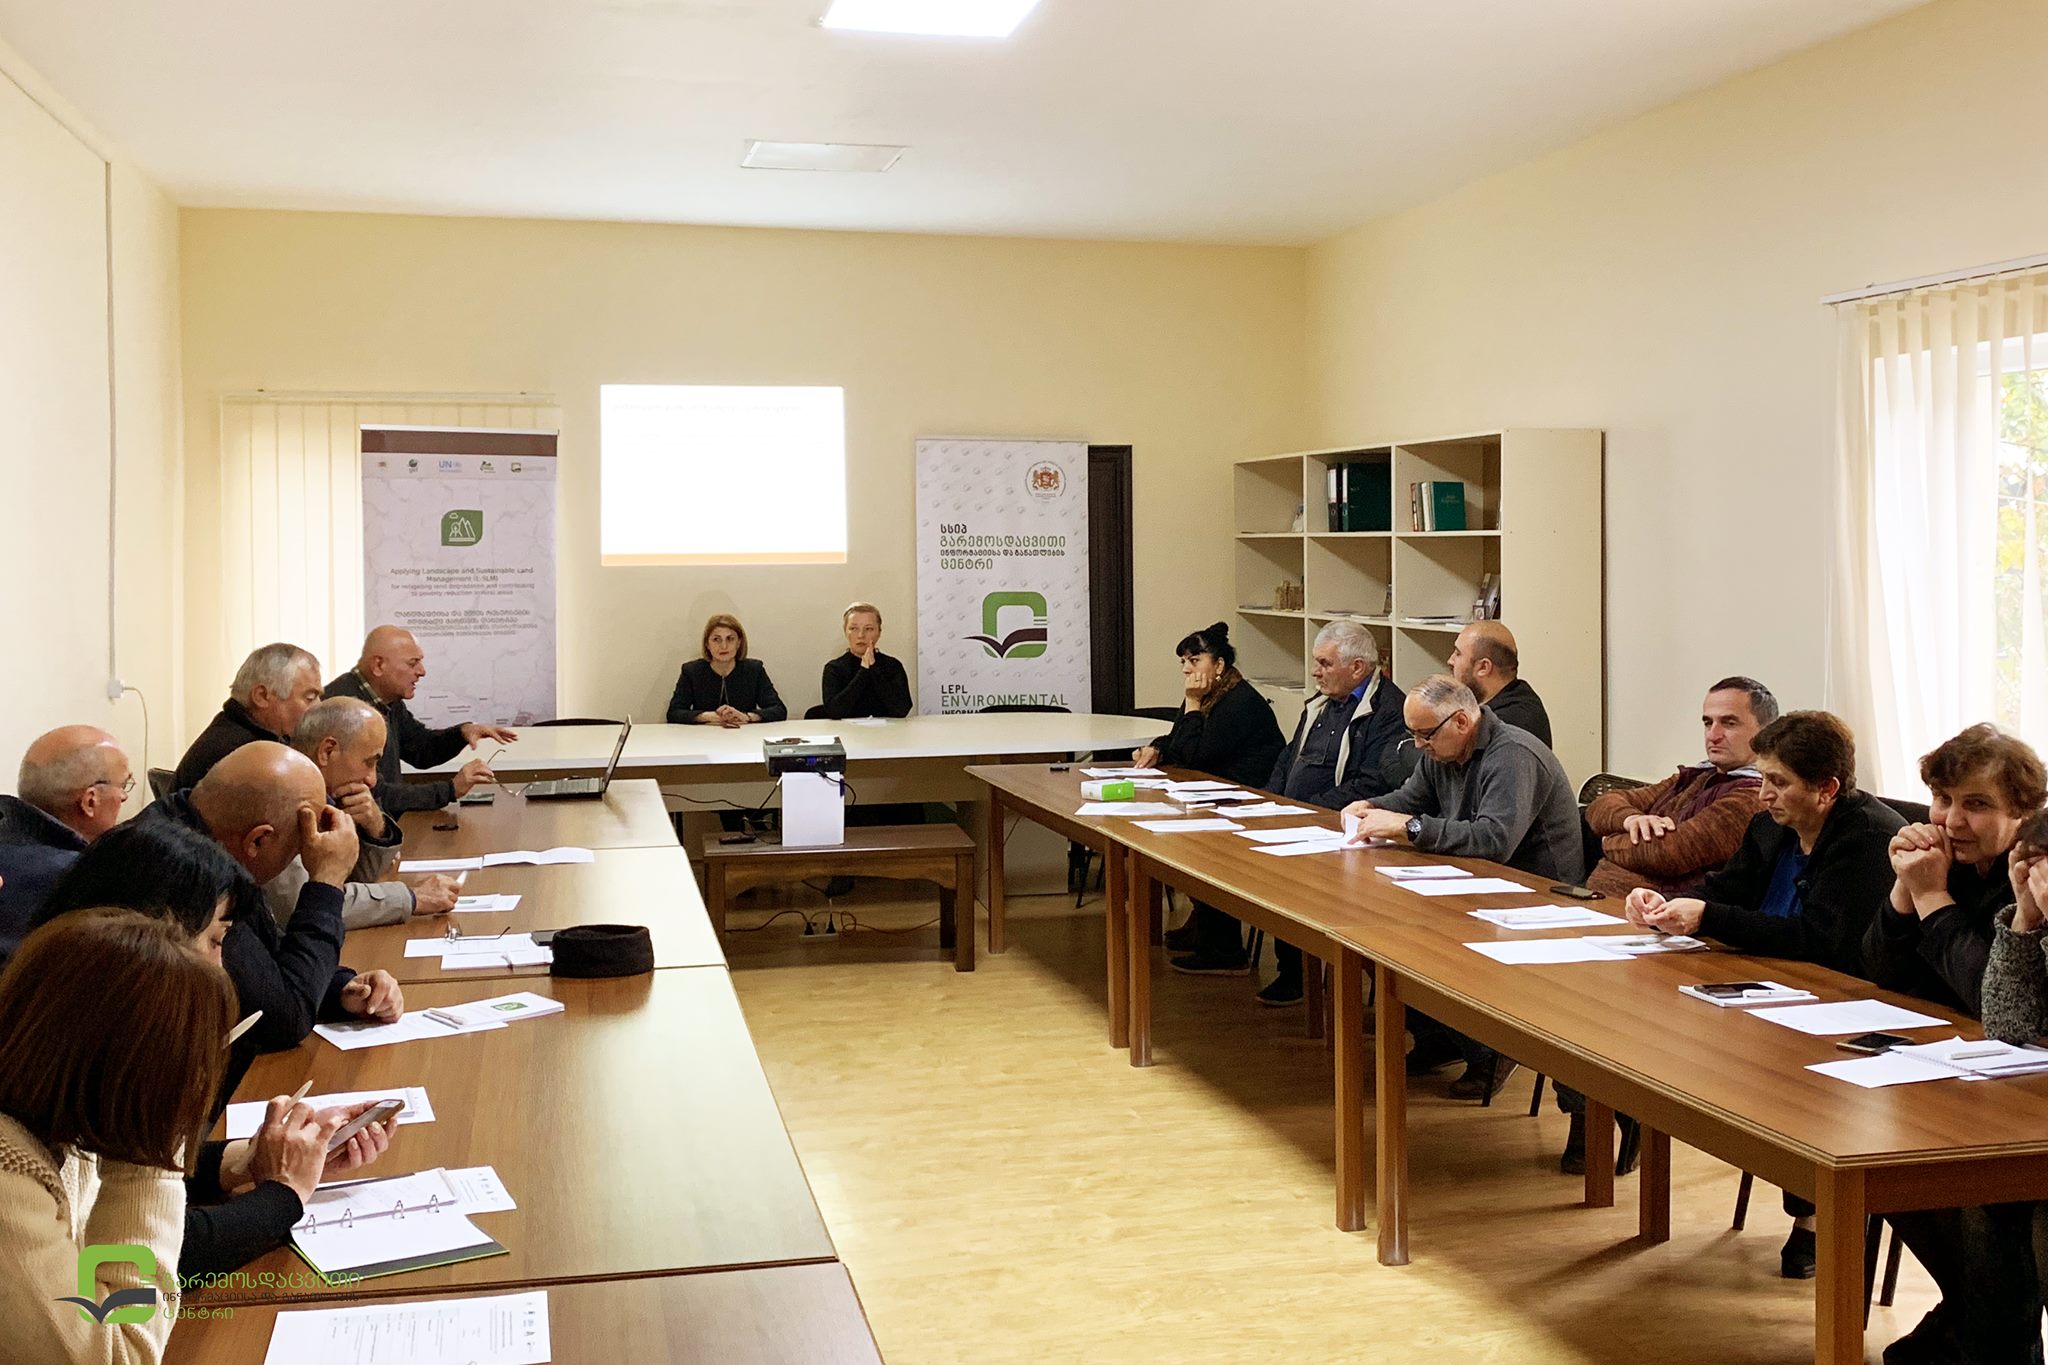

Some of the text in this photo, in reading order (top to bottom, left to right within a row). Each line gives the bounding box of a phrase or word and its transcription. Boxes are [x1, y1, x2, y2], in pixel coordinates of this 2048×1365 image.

[940, 523, 968, 534] სსიპ
[940, 535, 1066, 547] გარემოსდაცვითი
[940, 549, 1066, 557] ინფორმაციისა და განათლების
[940, 558, 993, 570] ცენტრი
[941, 684, 968, 694] LEPL
[941, 693, 1069, 708] ENVIRONMENTAL
